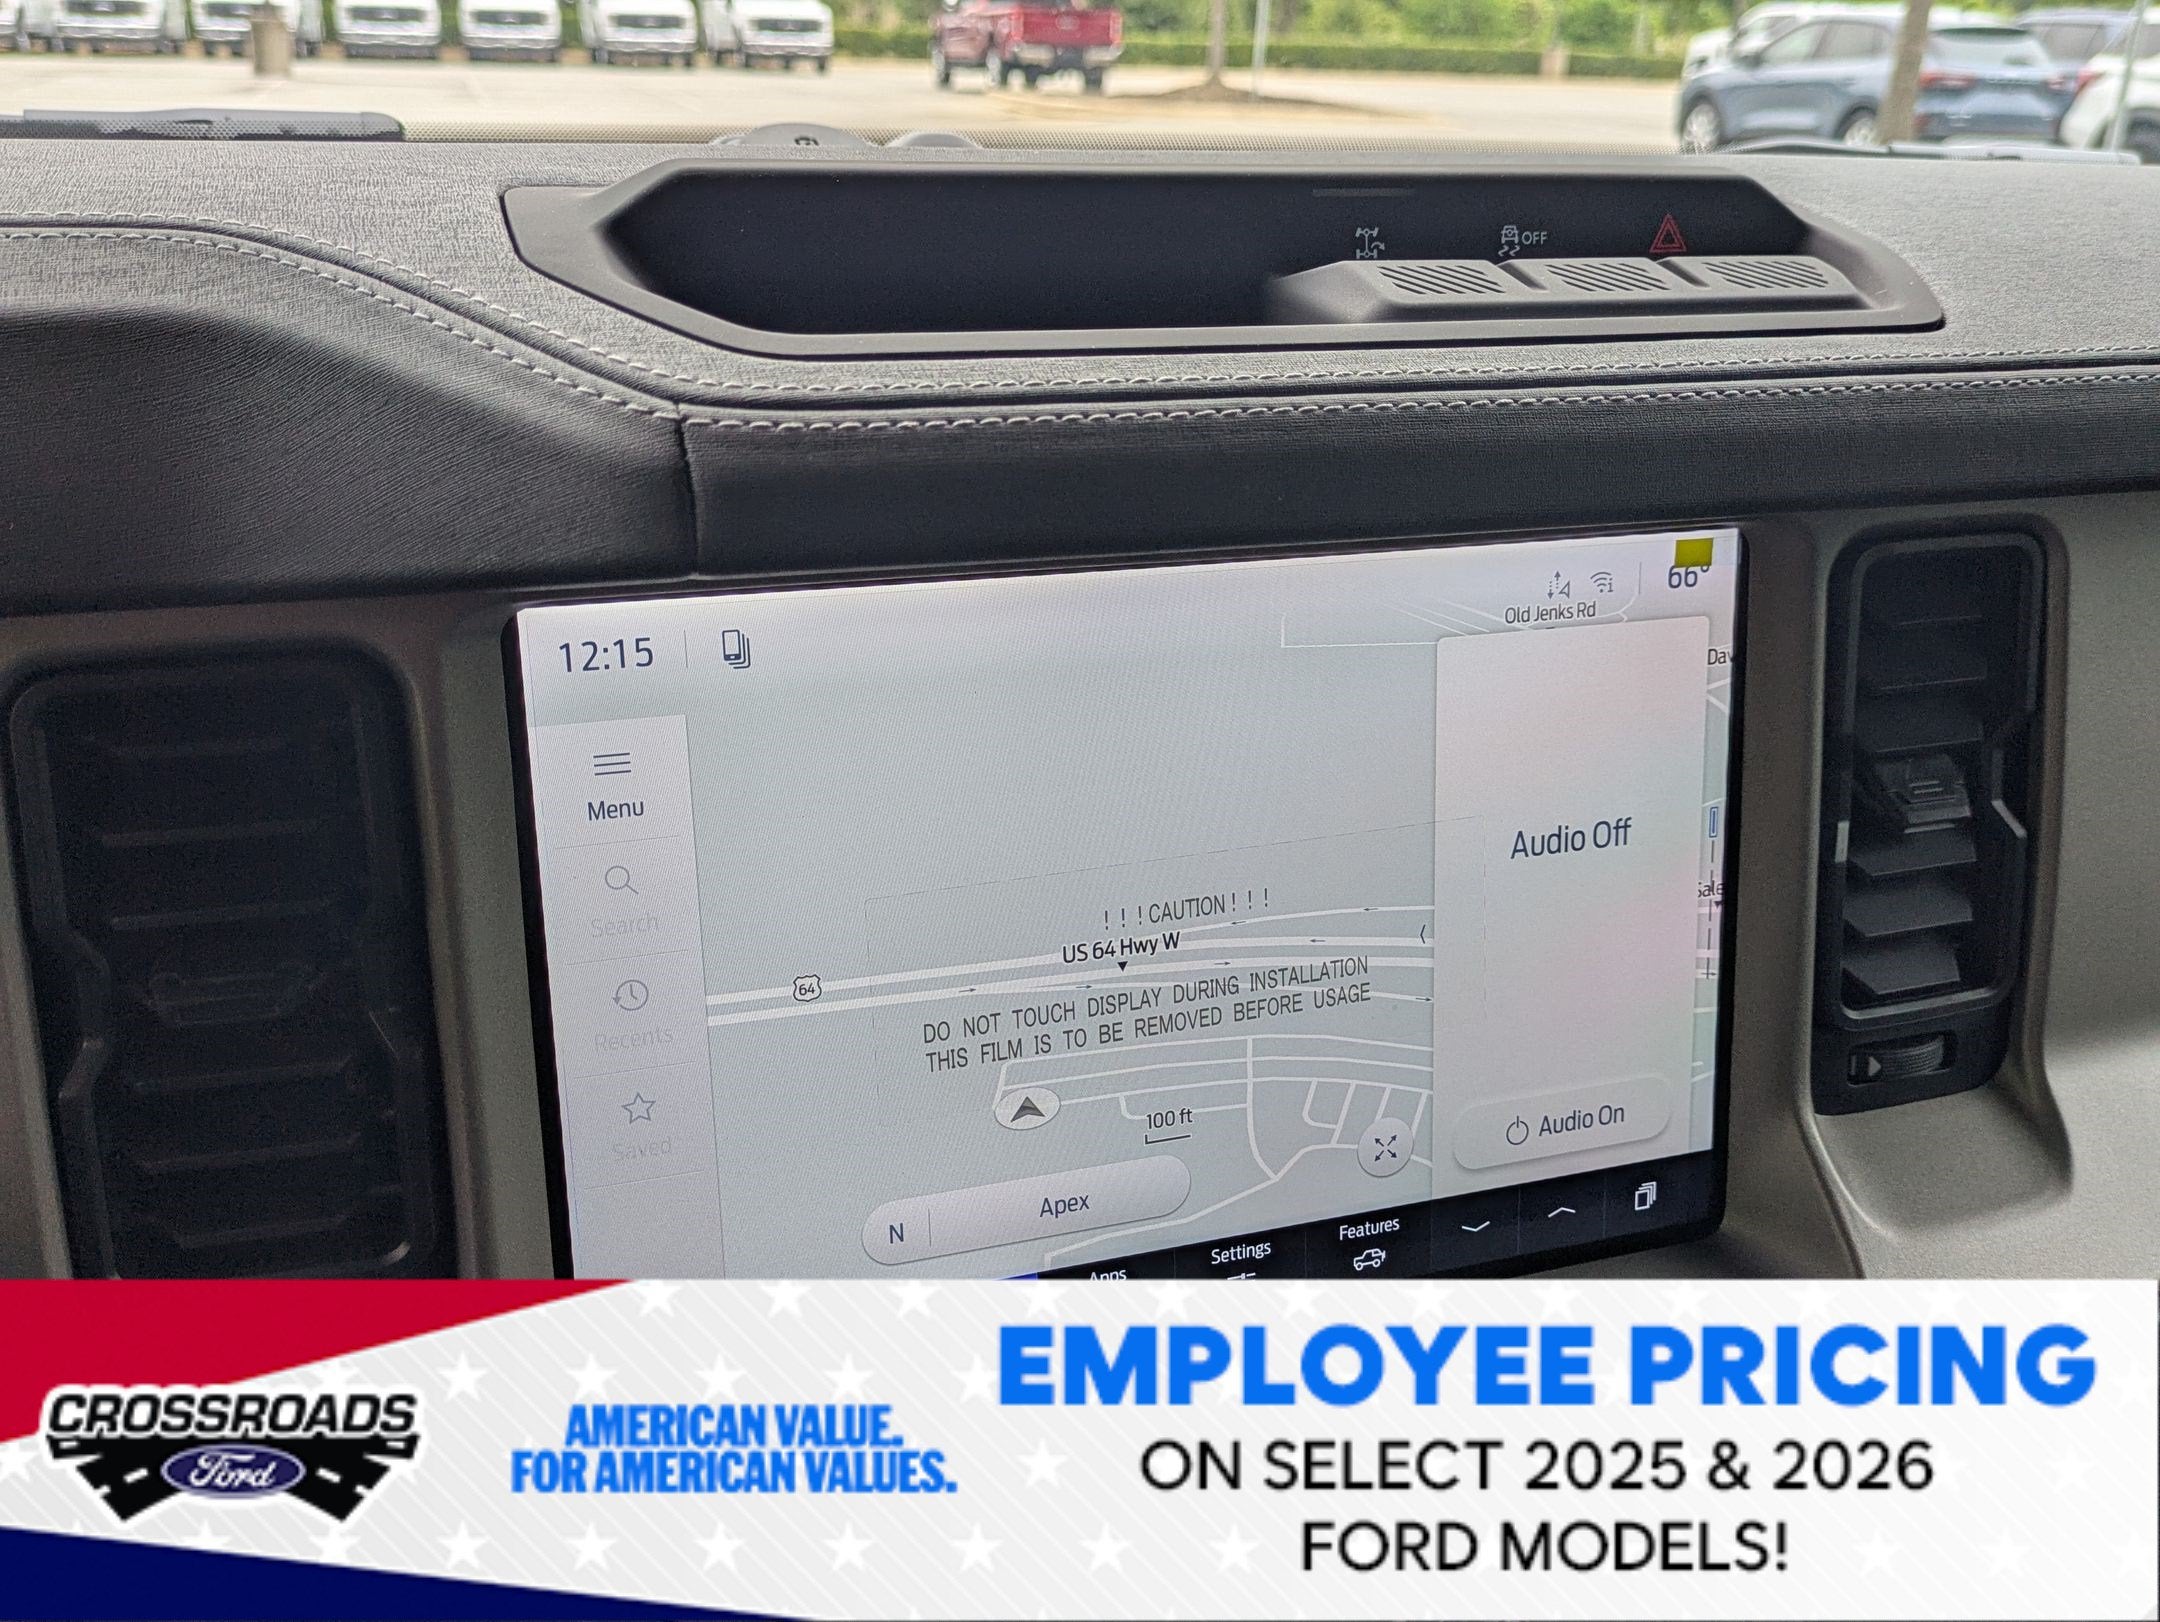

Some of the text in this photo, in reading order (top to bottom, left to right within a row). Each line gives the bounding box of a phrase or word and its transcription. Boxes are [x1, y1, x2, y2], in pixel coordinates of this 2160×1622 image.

[1522, 230, 1548, 245] OFF
[1505, 600, 1597, 624] Old Jenks Rd
[559, 637, 653, 672] 12:15
[587, 800, 645, 821] Menu
[1511, 817, 1633, 859] Audio Off
[591, 914, 660, 939] Search
[1062, 931, 1181, 963] US 64 Hwy W
[798, 982, 815, 996] 64
[924, 955, 1369, 1043] DO NOT TOUCH DISPLAY DURING INSTALLATION
[926, 982, 1372, 1073] THIS FILM IS TO BE REMOVED BEFORE USAGE
[1146, 1107, 1193, 1130] 100 ft
[1539, 1104, 1625, 1137] Audio On
[1039, 1194, 1090, 1219] Apex
[889, 1222, 905, 1245] N
[1338, 1218, 1400, 1241] Features
[1210, 1242, 1272, 1265] Settings
